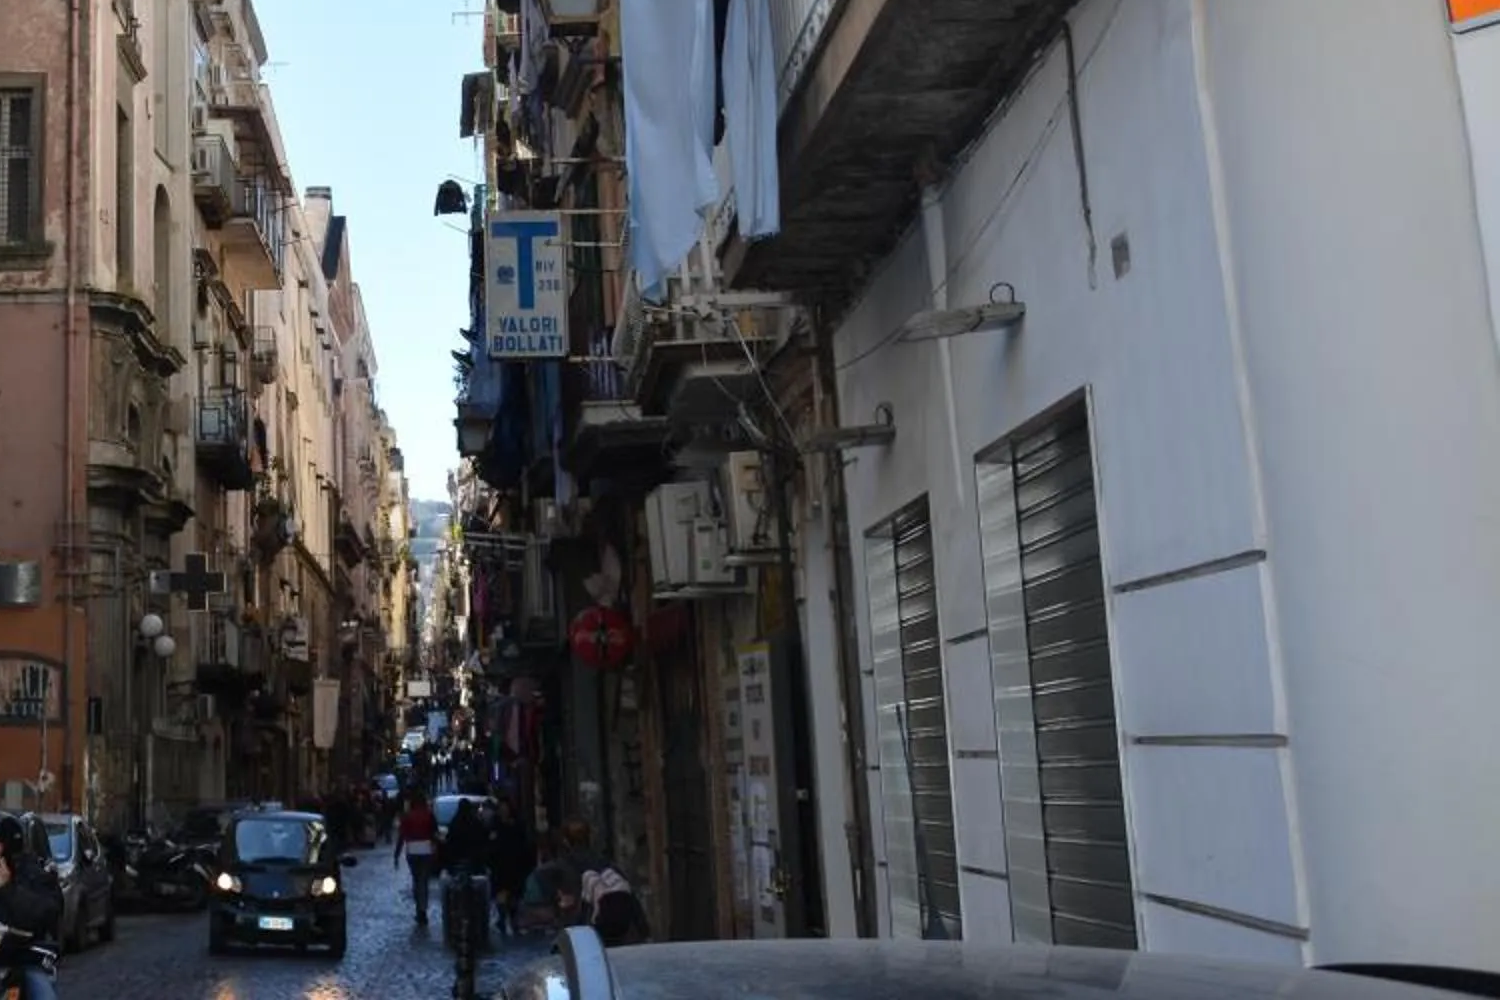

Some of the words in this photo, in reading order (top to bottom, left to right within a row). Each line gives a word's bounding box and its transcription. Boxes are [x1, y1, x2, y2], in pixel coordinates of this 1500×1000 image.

[491, 220, 558, 309] T
[499, 316, 558, 333] VALORI
[493, 335, 563, 352] BOLLATI
